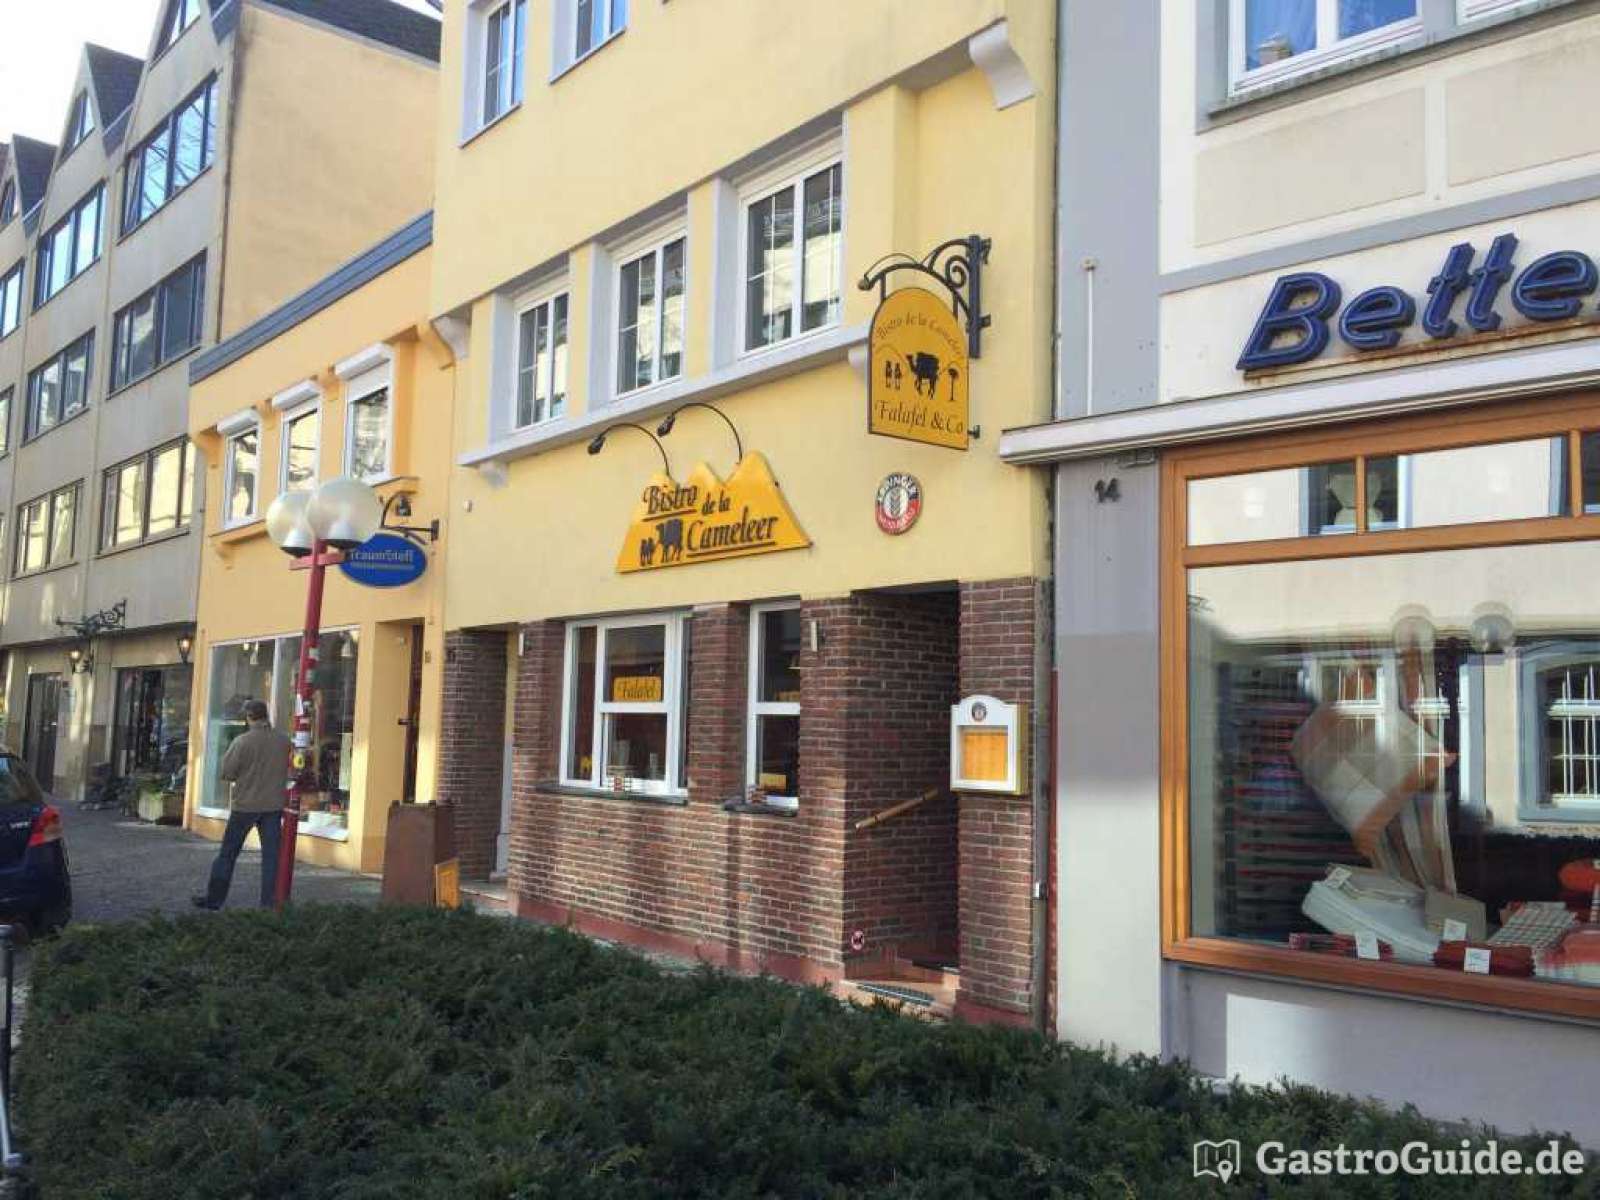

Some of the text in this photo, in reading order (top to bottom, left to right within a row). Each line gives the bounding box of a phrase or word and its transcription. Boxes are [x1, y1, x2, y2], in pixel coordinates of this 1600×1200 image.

[1235, 232, 1600, 370] Bette
[875, 398, 928, 429] Falafel
[642, 484, 732, 515] Bistro de la
[1094, 478, 1122, 504] 14
[686, 506, 779, 551] Cameleer
[616, 678, 657, 700] Falafel
